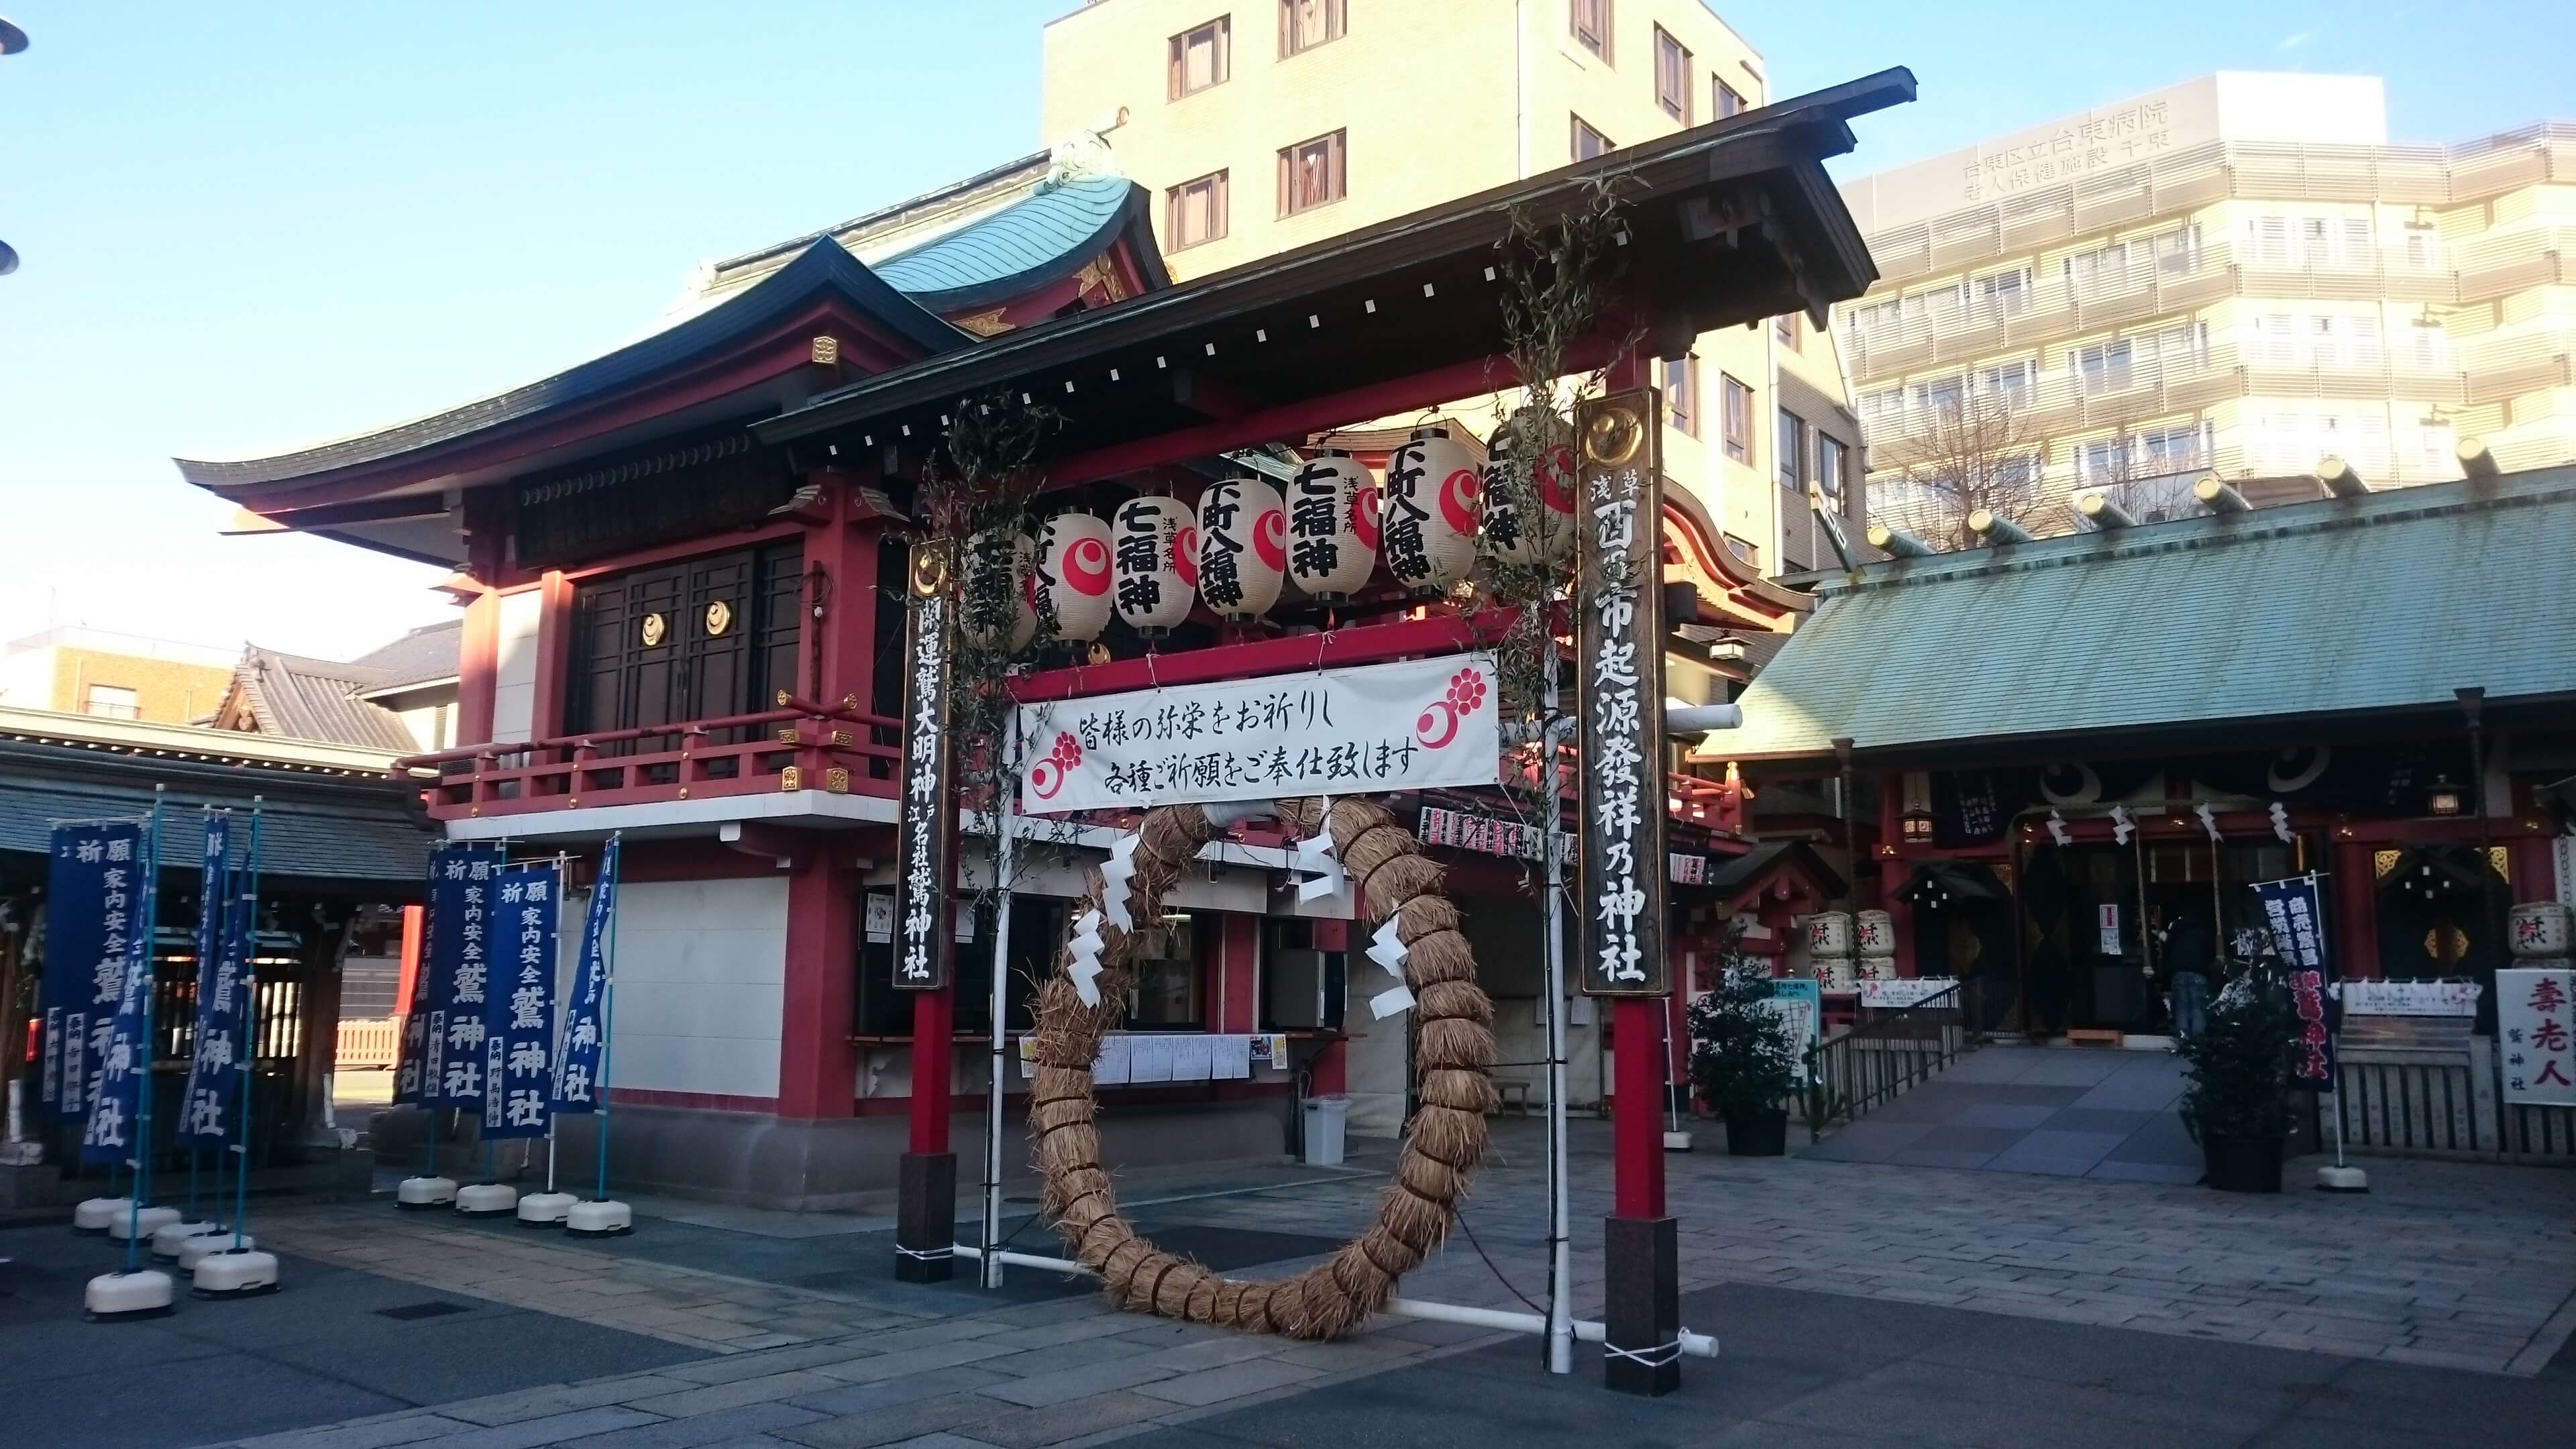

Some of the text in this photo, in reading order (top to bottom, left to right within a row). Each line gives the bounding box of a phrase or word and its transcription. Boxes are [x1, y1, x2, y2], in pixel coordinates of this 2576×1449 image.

[1199, 480, 1244, 608] 下町八福神
[1290, 463, 1339, 578] 七福神
[1343, 476, 1359, 535] 浅草名所
[1385, 440, 1432, 582] 下町八福神
[1116, 501, 1161, 616] 七福神
[1163, 516, 1178, 576] 浅草名所
[1078, 689, 1335, 752] 皆様の弥栄をお祈りし
[1104, 735, 1419, 795] 各種ご祈願をご奉仕致します
[76, 837, 132, 865] 祈願
[444, 859, 490, 881] 祈願
[103, 867, 128, 953] 家内安全
[462, 885, 485, 961] 家内安全
[500, 879, 548, 904] 祈願
[519, 906, 543, 985] 家内安全
[443, 962, 488, 1098] 鷲神社
[506, 985, 547, 1128] 鷲神社
